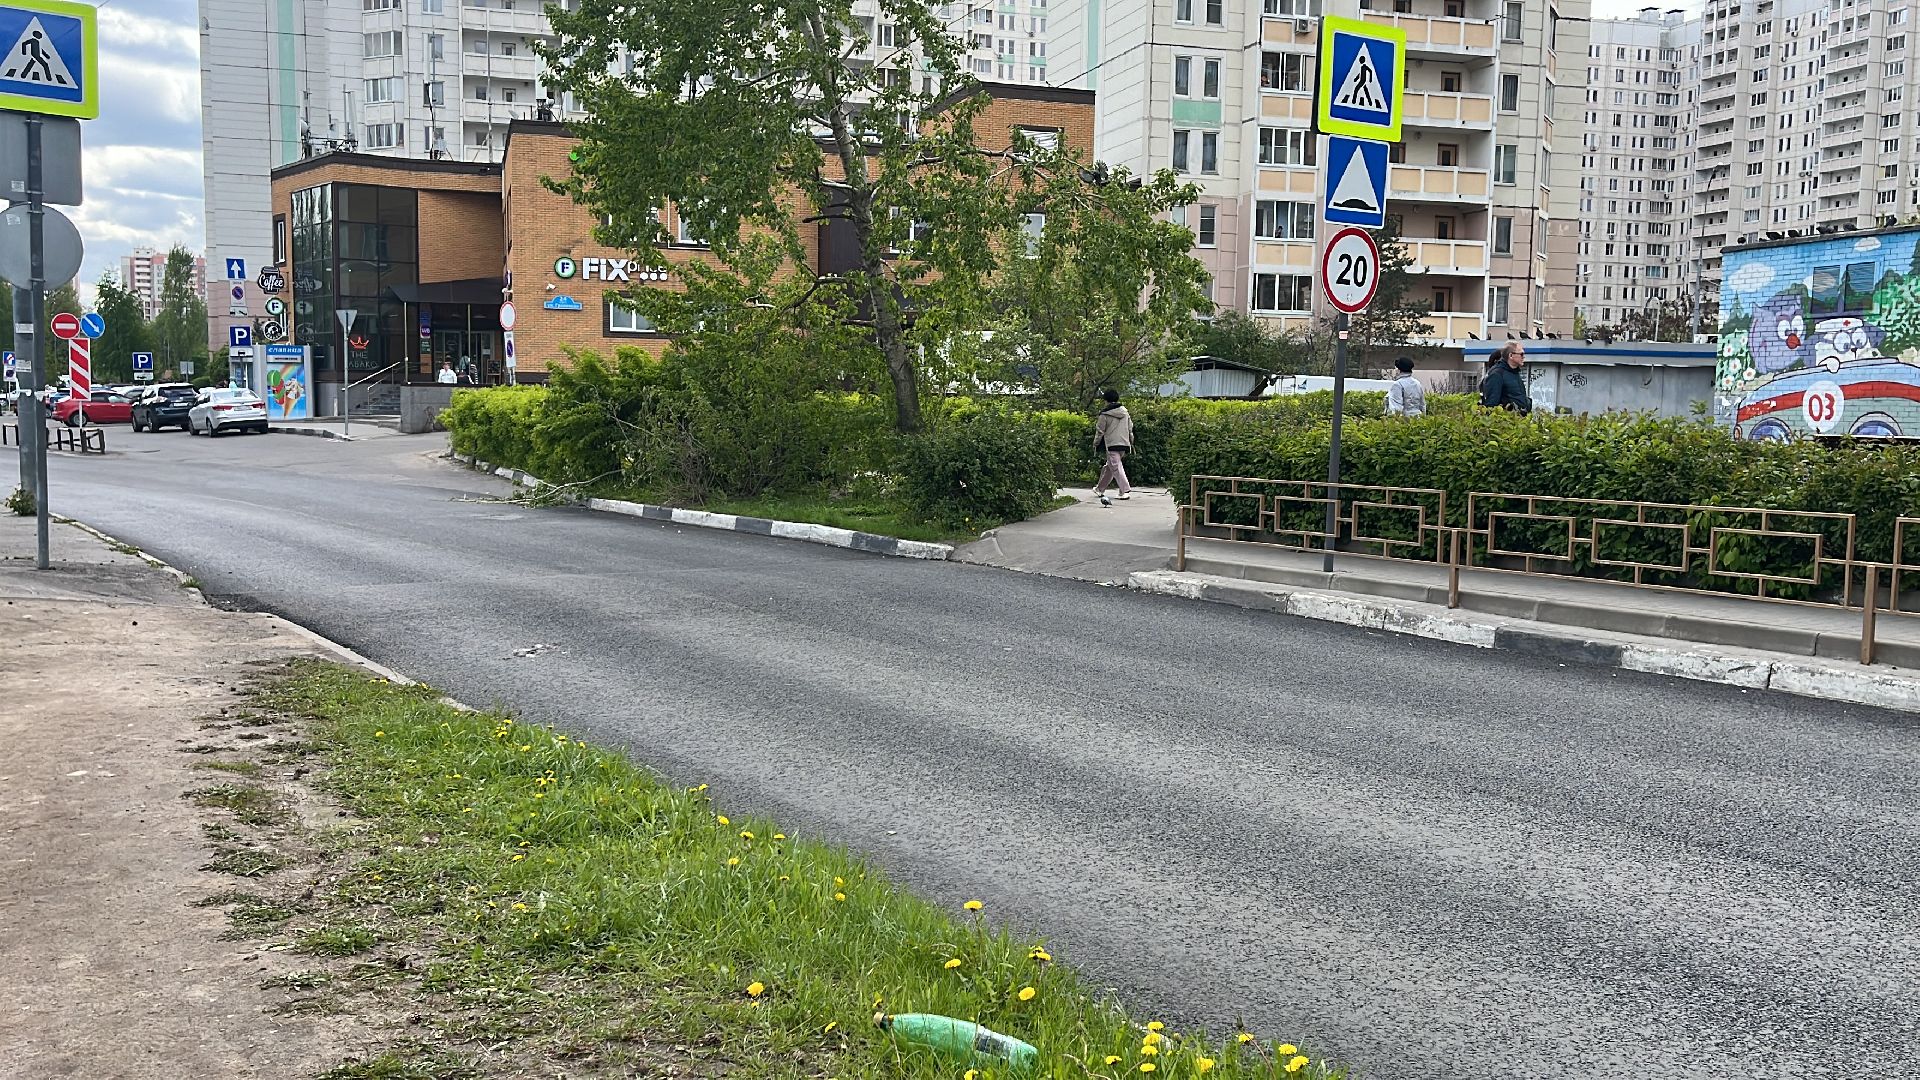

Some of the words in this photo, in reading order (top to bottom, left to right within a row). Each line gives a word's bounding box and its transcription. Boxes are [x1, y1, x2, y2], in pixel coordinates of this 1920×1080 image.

[1336, 253, 1368, 287] 20
[259, 274, 284, 291] Coffee
[350, 351, 368, 359] THE
[1808, 392, 1836, 422] 03
